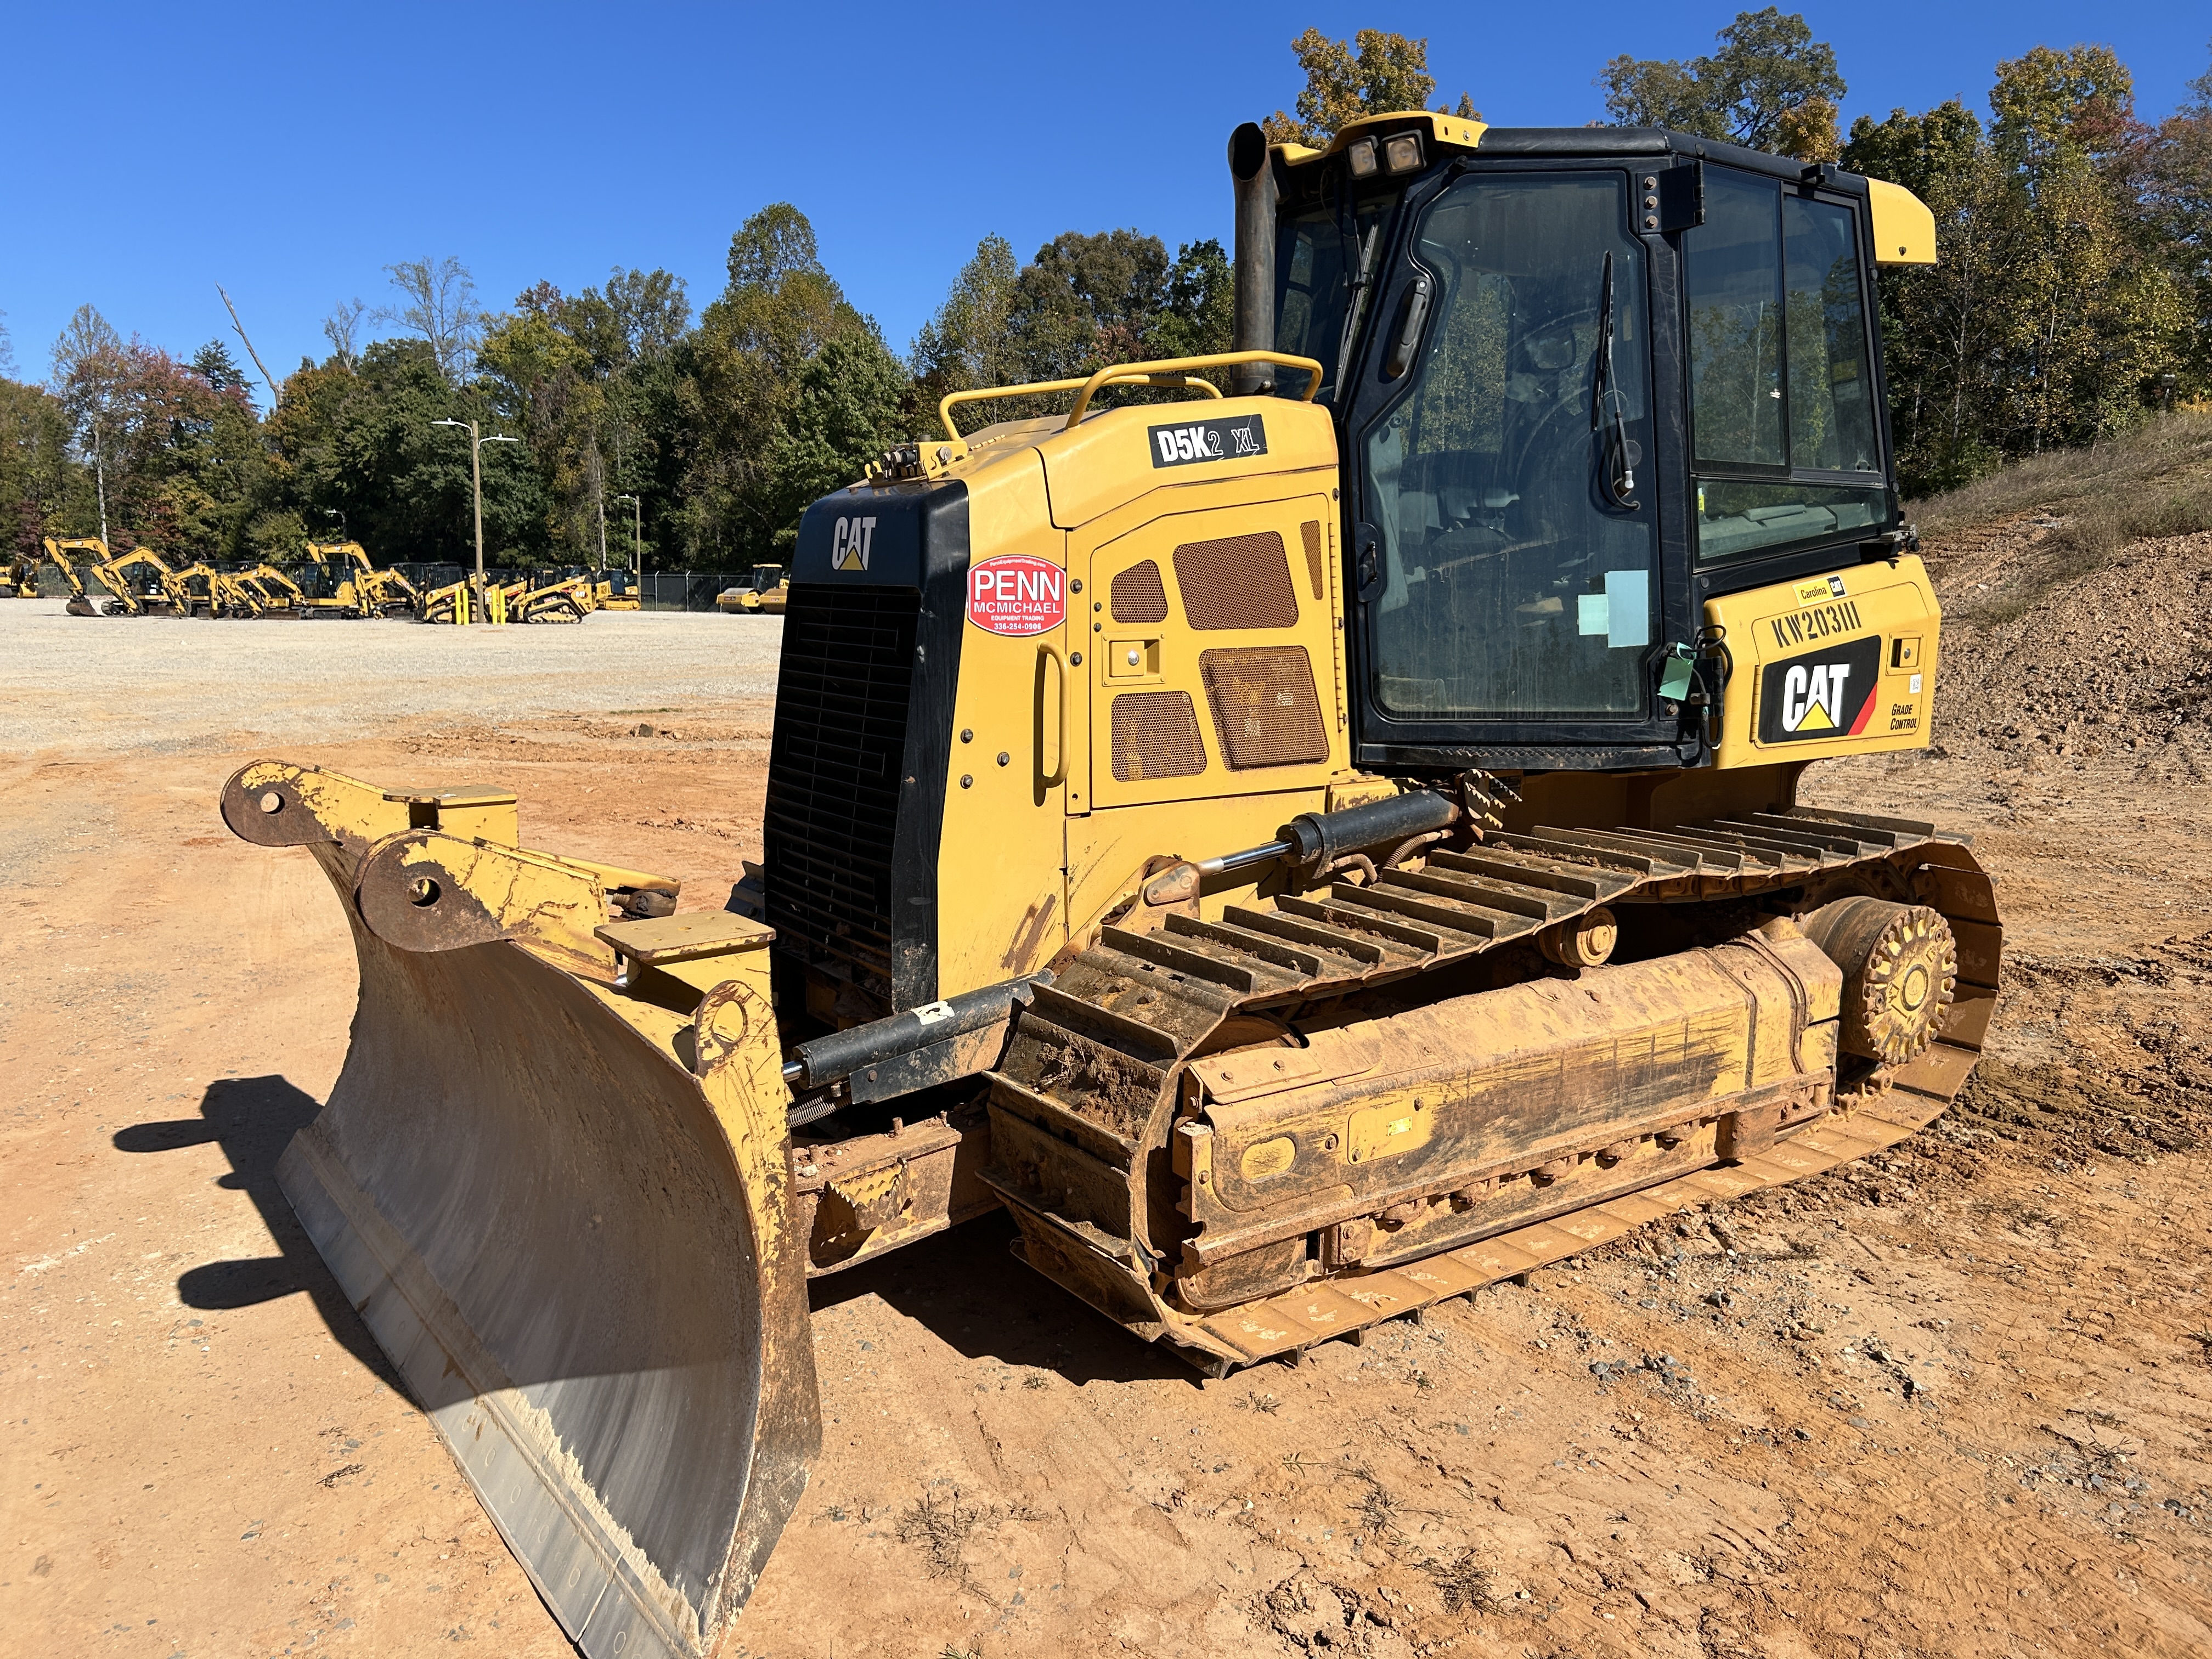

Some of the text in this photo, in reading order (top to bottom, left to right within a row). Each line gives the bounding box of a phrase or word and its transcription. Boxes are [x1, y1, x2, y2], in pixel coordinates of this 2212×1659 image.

[1157, 426, 1260, 462] D5K2 XL
[832, 517, 877, 571] CAT
[974, 570, 1060, 601] PENN
[1801, 586, 1827, 599] Carolina
[974, 602, 1060, 613] MCMICHAEL
[1782, 663, 1850, 732] CAT
[1891, 703, 1913, 716] GRADE
[1890, 718, 1917, 730] CONTROL
